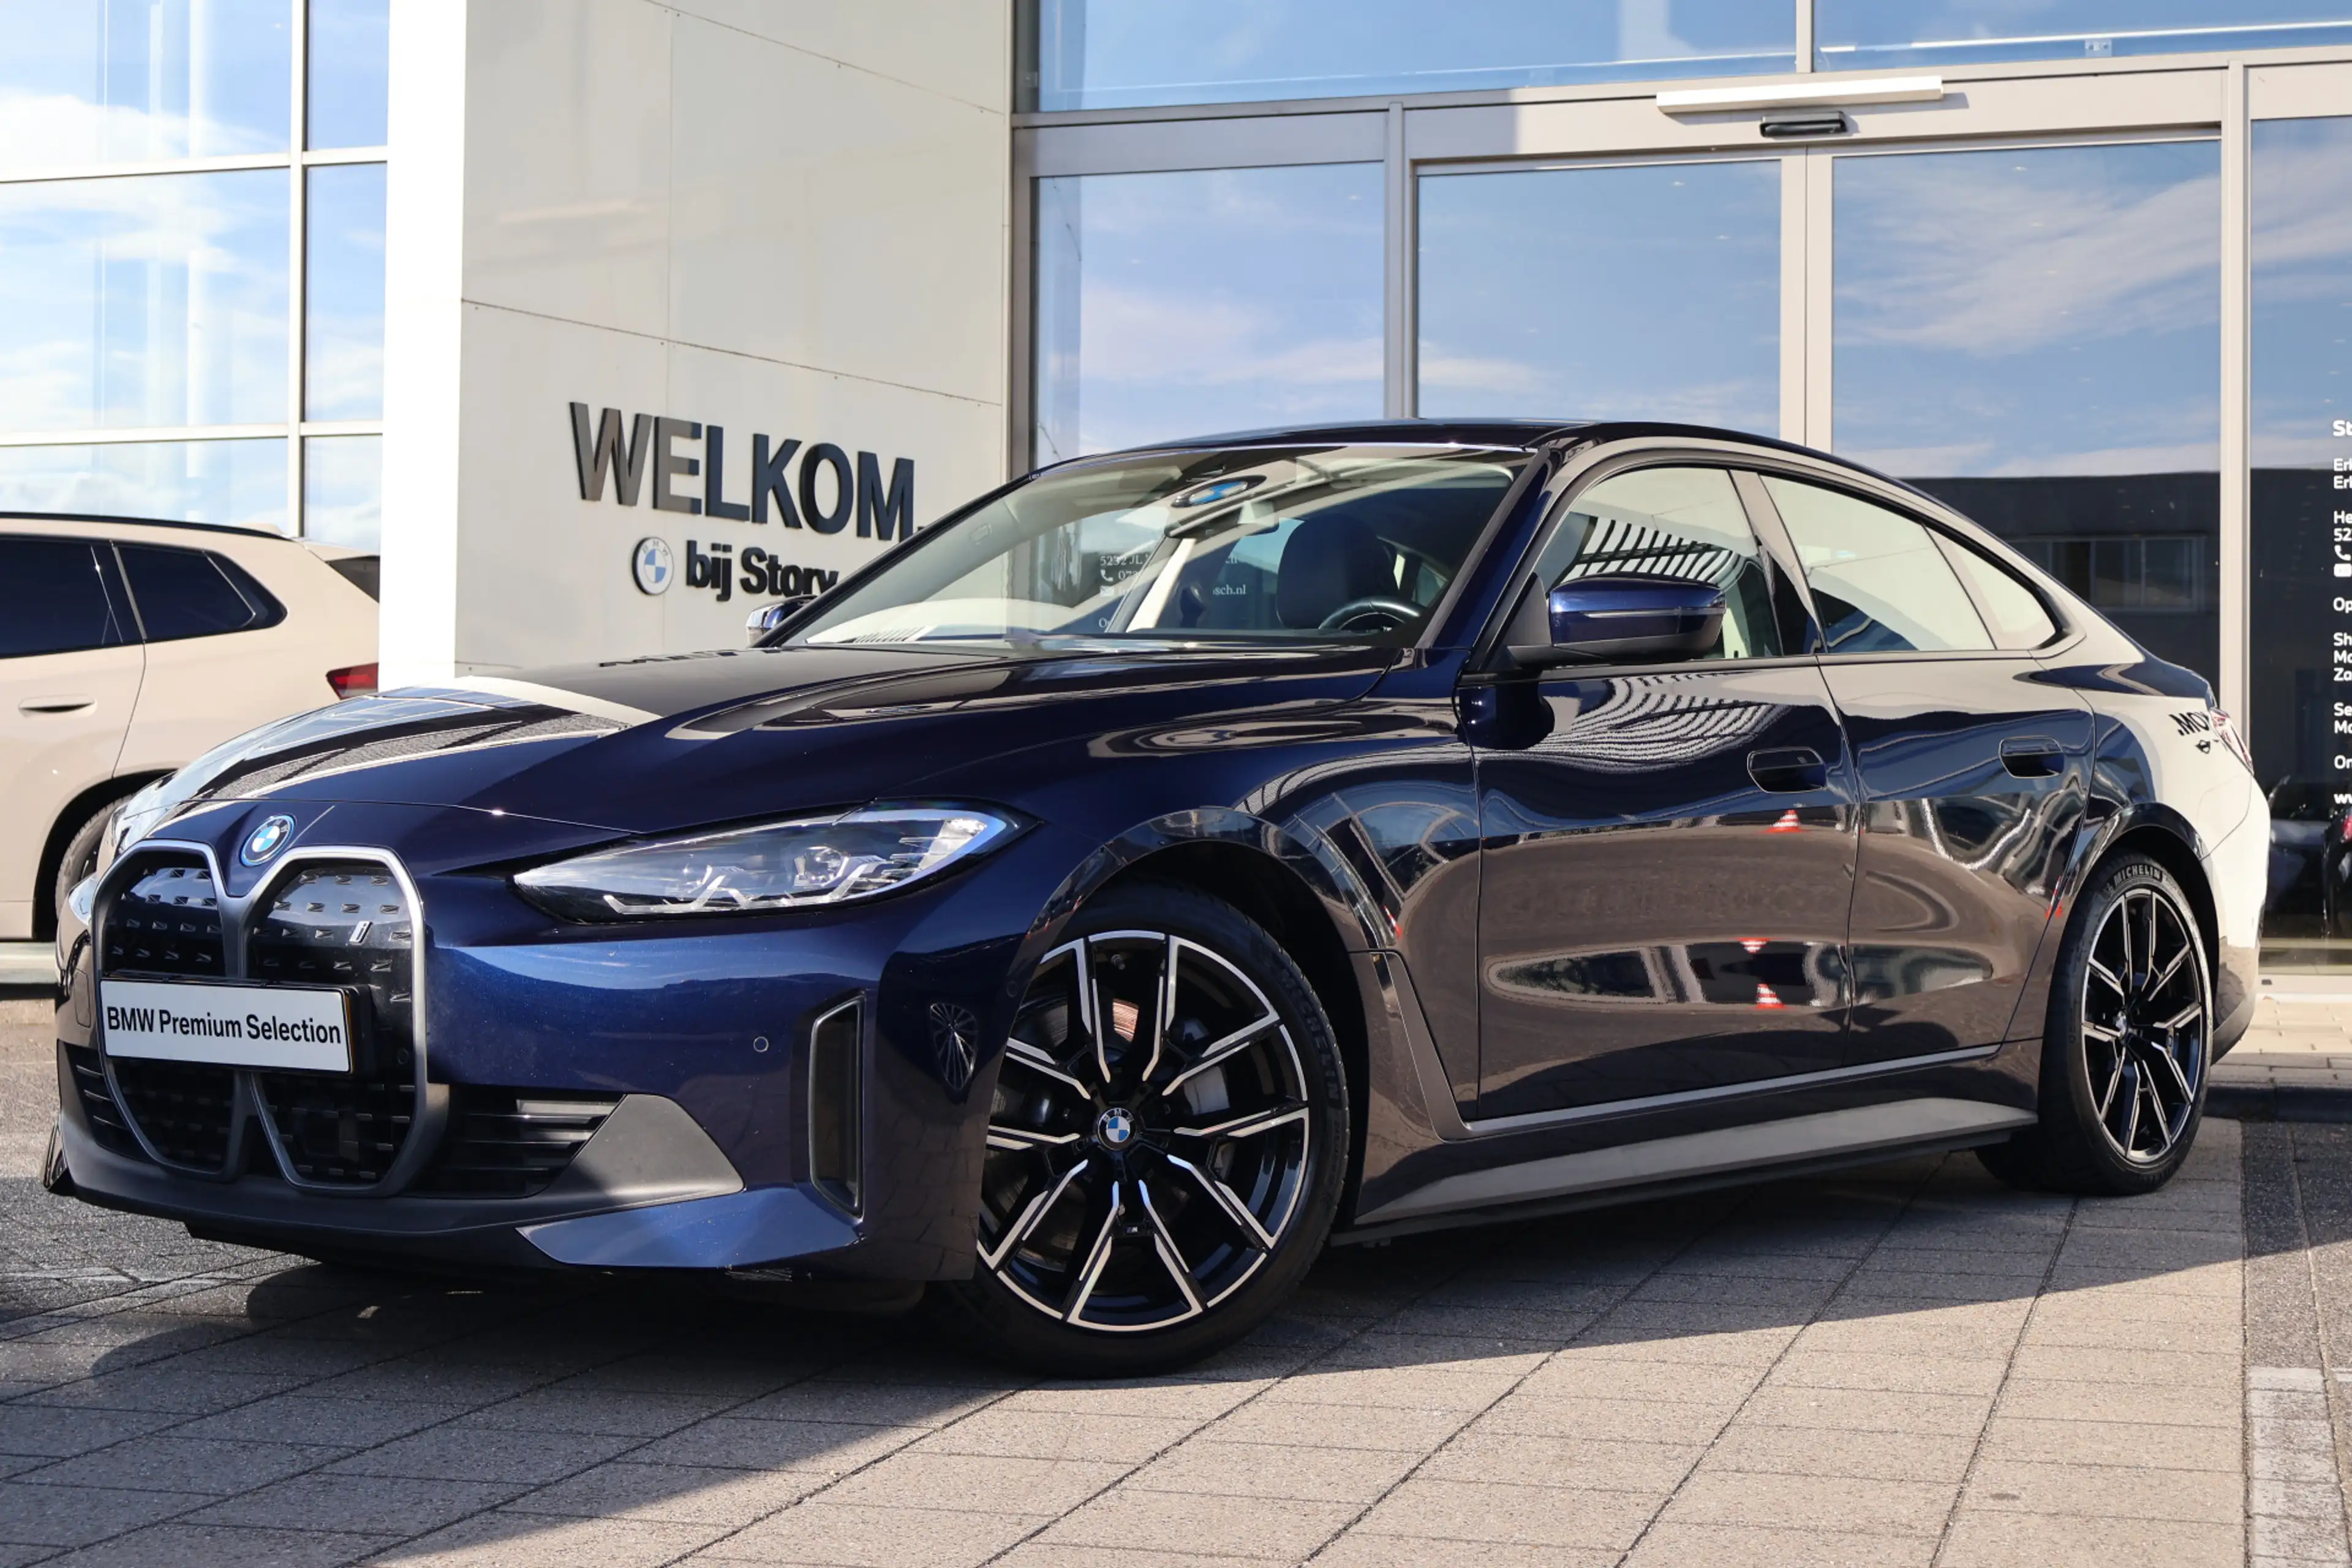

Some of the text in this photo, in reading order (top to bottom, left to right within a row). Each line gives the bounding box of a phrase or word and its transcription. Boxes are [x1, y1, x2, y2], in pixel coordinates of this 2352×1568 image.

[570, 402, 927, 543] WELKOM
[687, 540, 732, 601] bij
[1213, 584, 1246, 595] sch.nl
[2113, 864, 2162, 886] MICHELIN
[107, 1006, 342, 1044] BMW Premium Selection
